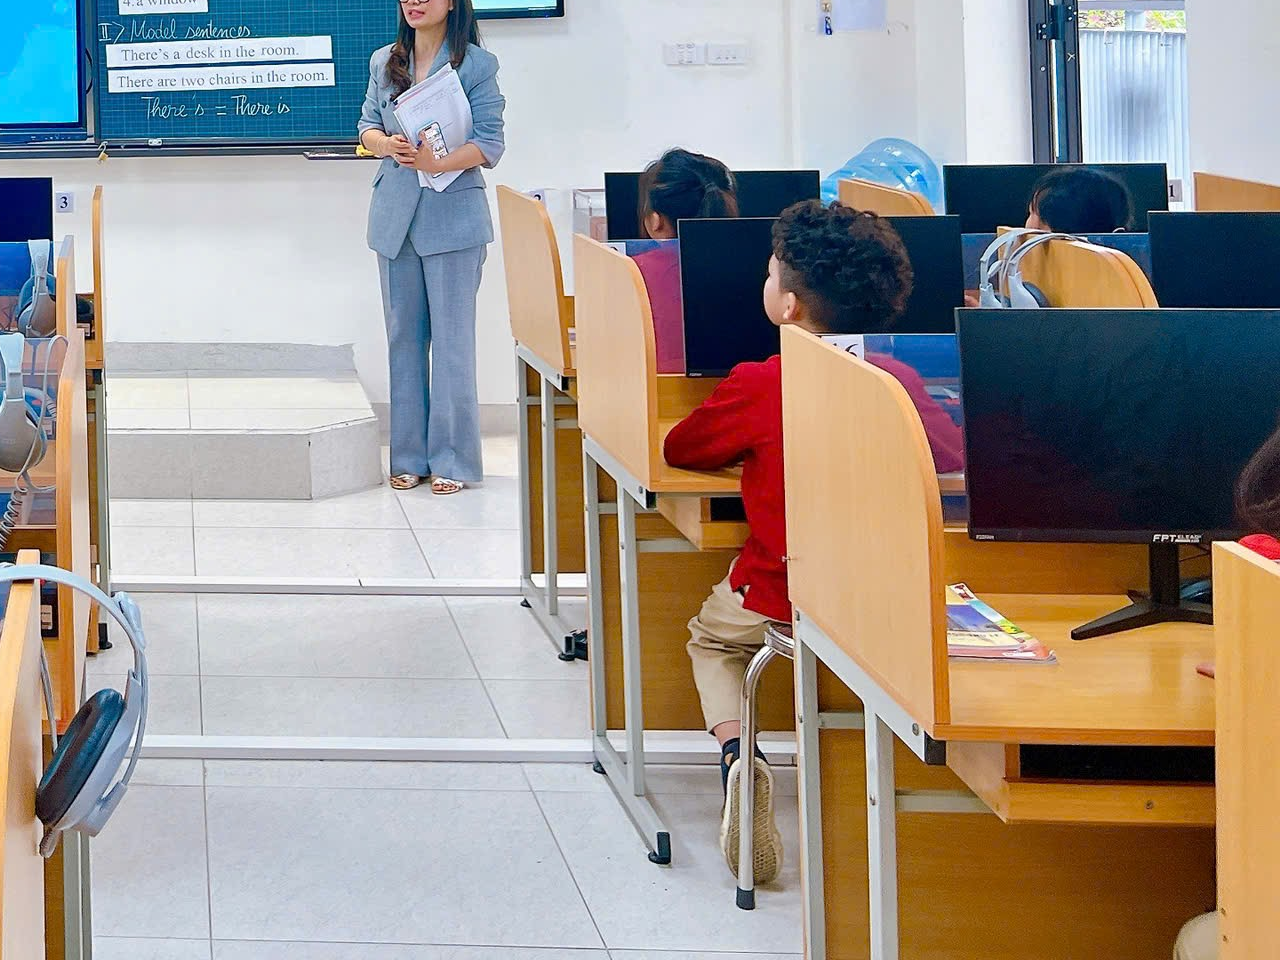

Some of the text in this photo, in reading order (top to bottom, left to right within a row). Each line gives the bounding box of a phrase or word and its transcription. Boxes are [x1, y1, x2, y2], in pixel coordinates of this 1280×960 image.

[130, 19, 176, 42] Model
[173, 52, 180, 60] a
[186, 47, 215, 59] desk
[220, 47, 231, 58] in
[235, 46, 255, 57] the
[260, 45, 299, 56] room.
[117, 71, 329, 88] There are two chairs in the room.
[231, 95, 273, 117] There
[277, 96, 291, 114] is
[60, 196, 68, 209] 3
[1152, 534, 1177, 543] FPT
